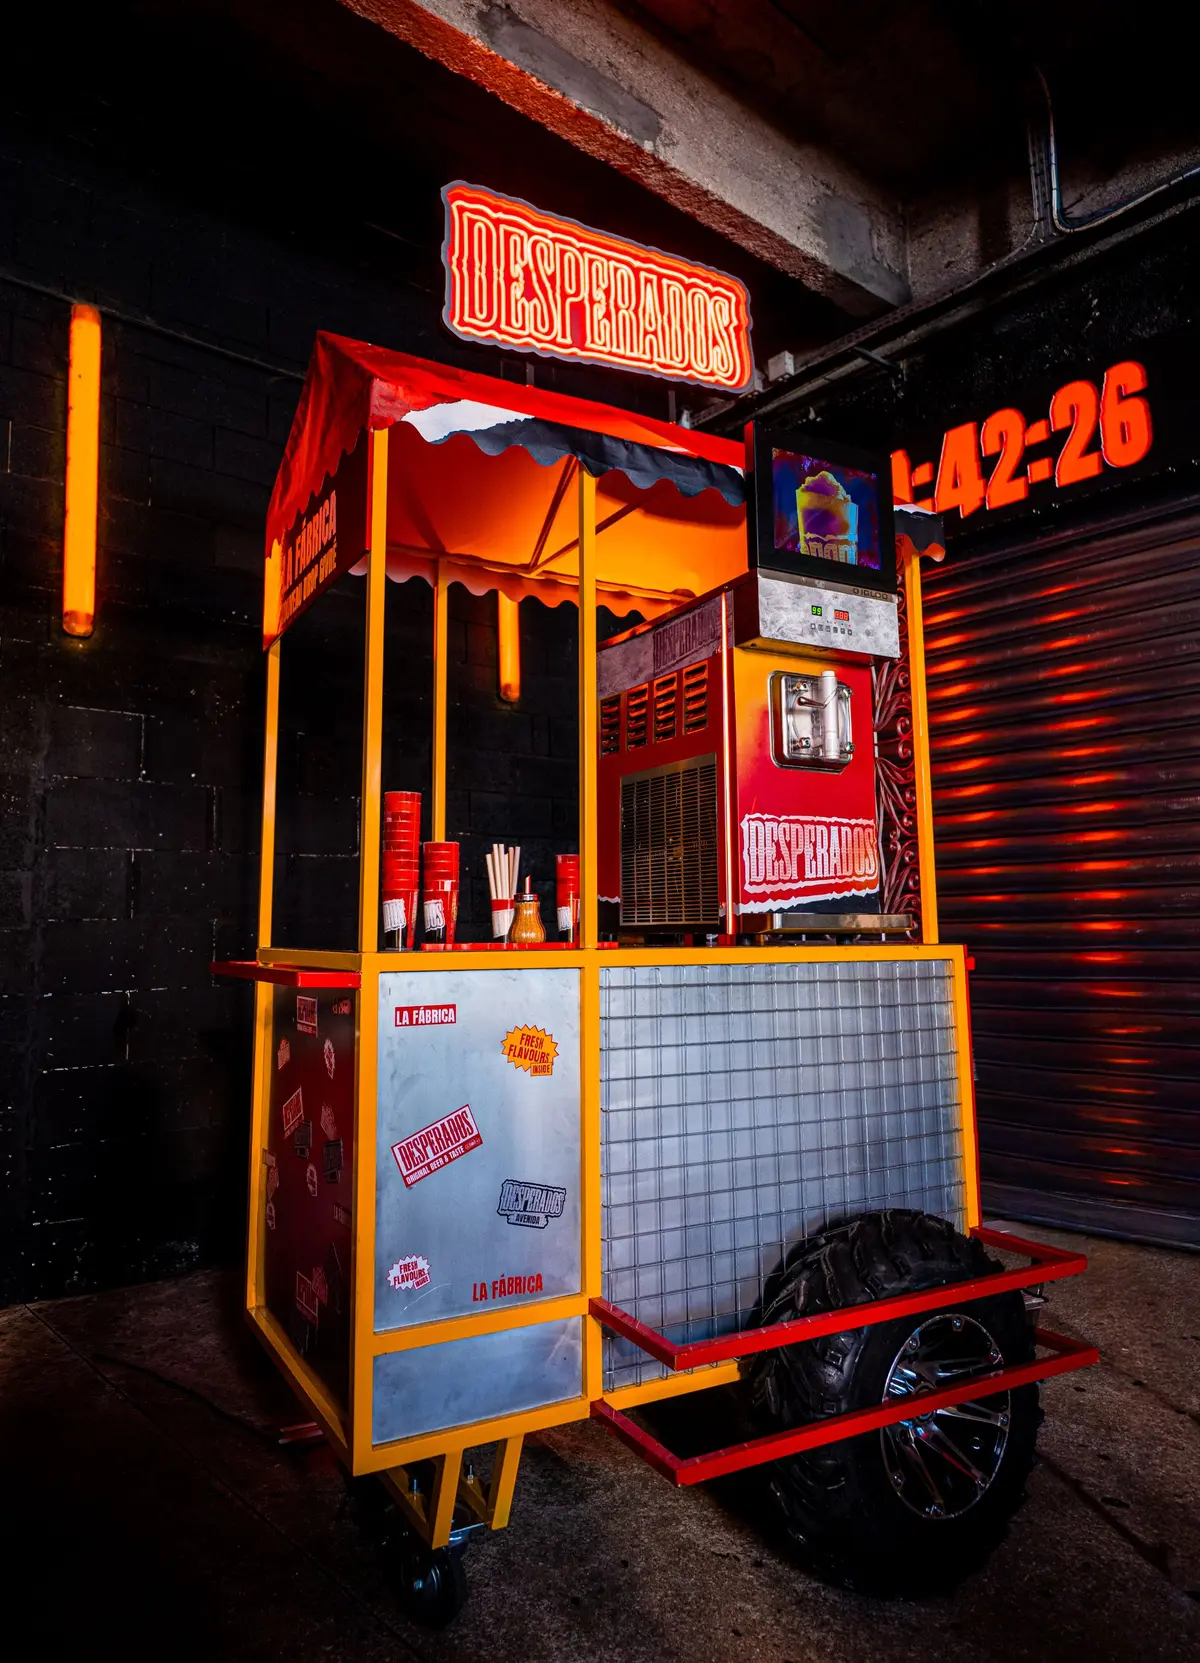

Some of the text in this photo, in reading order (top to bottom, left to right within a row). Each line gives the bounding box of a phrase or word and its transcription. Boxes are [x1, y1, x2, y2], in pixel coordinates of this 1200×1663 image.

[463, 212, 734, 378] DESPERADOS
[295, 489, 337, 580] FÁBRICA
[749, 821, 877, 883] DESPERADOS
[396, 1007, 456, 1025] LA FÁBRICA
[520, 1033, 544, 1048] FRESH
[508, 1044, 550, 1063] FLAVOURS
[532, 1065, 550, 1074] INSIDE
[398, 1110, 475, 1172] DESPERADOS
[406, 1163, 430, 1185] ORIGINAL
[430, 1157, 443, 1172] BEER
[449, 1147, 465, 1160] TASTE
[502, 1183, 563, 1215] DESPERADOS
[515, 1214, 540, 1225] AVENIDA
[393, 1268, 427, 1285] FLAVOURS
[399, 1261, 418, 1272] FRESH
[472, 1273, 543, 1302] LA FÁBRICA
